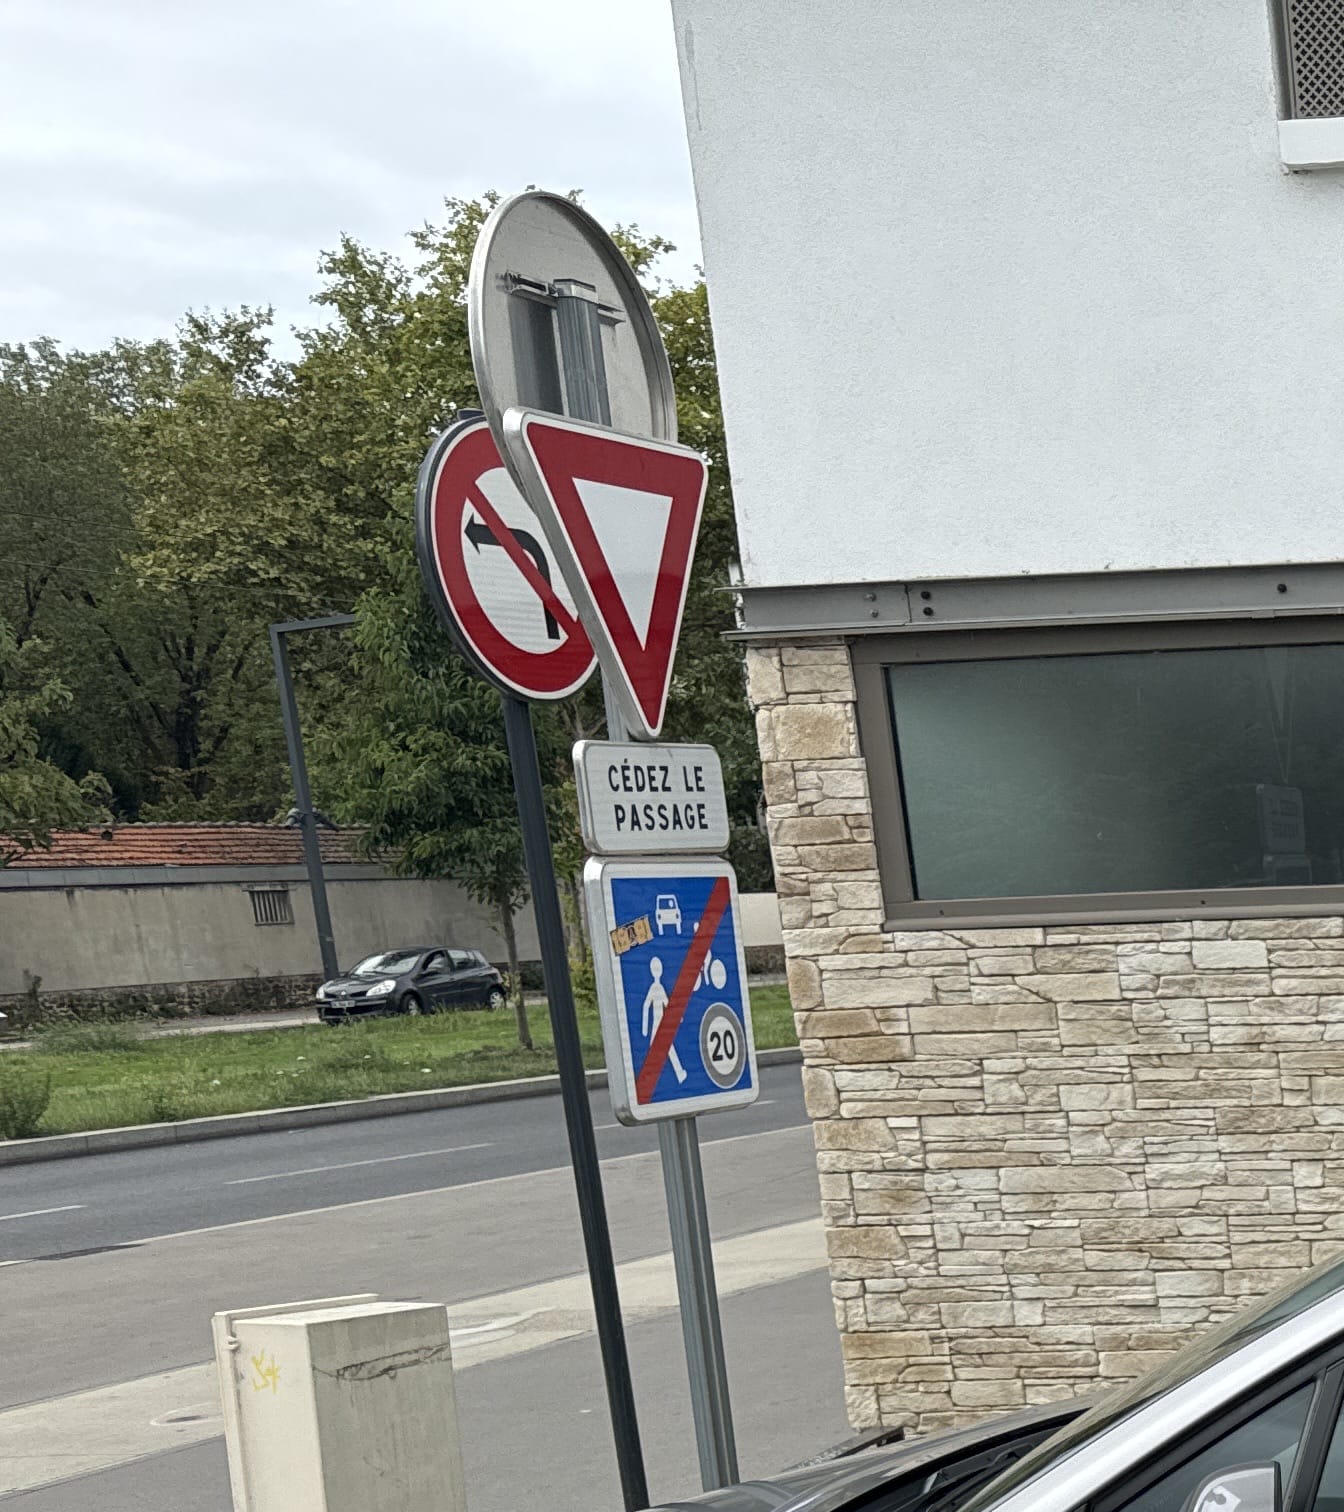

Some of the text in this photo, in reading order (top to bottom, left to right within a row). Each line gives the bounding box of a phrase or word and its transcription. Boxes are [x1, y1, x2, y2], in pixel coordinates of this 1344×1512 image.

[608, 758, 705, 792] CÉDEZ LE
[614, 803, 709, 832] PASSAGE
[710, 1030, 735, 1061] 20
